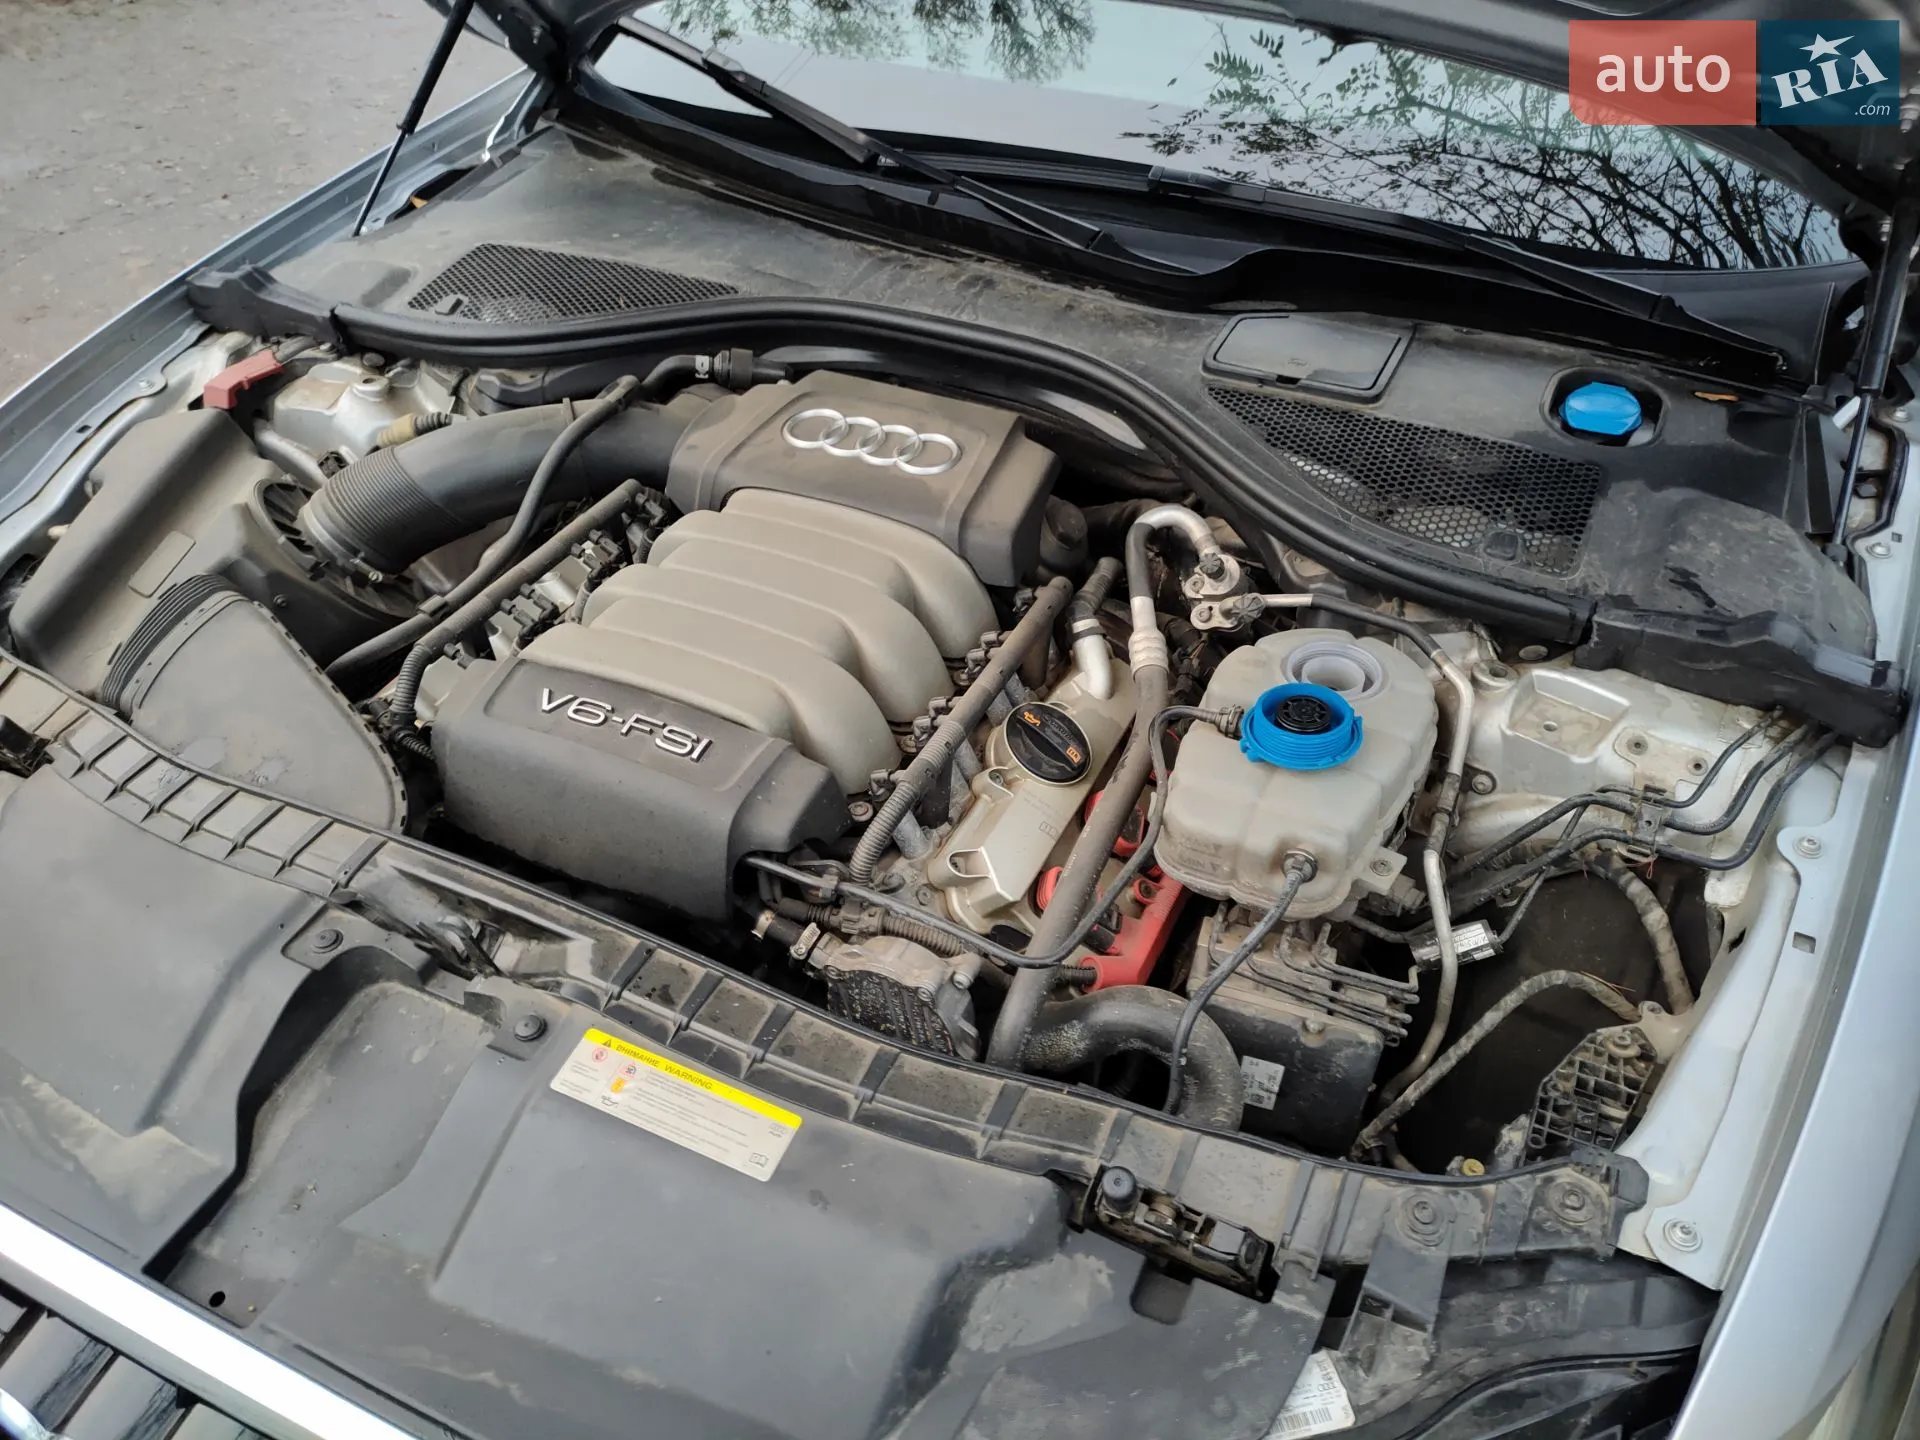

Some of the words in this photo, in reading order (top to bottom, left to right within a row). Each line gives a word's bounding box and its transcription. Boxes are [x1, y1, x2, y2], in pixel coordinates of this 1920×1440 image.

[540, 686, 713, 763] V6-FSI
[615, 1044, 661, 1067] ВНИМАНИЕ
[664, 1064, 713, 1090] WARNING
